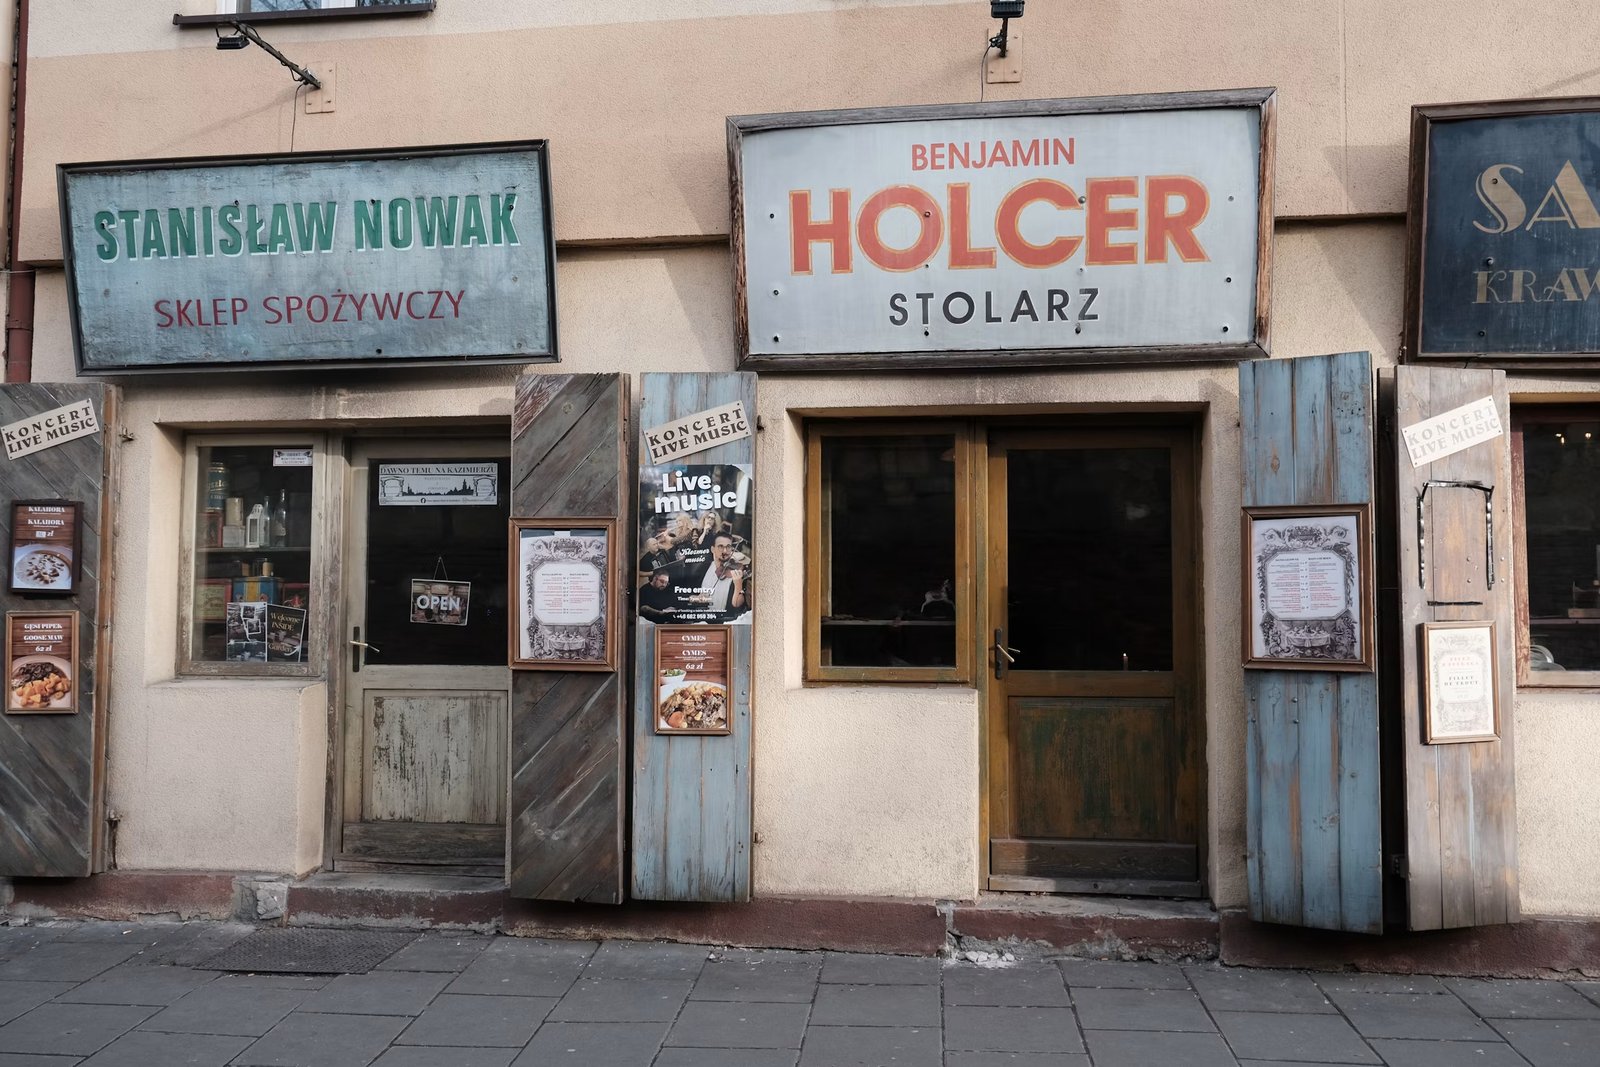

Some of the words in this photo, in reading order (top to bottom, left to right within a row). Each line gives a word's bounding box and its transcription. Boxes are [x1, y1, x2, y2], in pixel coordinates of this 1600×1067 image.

[911, 137, 1075, 171] BENJAMIN
[1472, 159, 1600, 234] SA
[94, 201, 338, 264] STANISŁAW
[354, 193, 521, 252] NOWAK
[789, 174, 1211, 276] HOLCER
[153, 297, 249, 329] SKLEP
[264, 288, 465, 325] SPOŻYWCZY
[889, 287, 1100, 326] STOLARZ
[5, 406, 91, 442] KONCERT
[8, 434, 42, 453] LIVE
[46, 418, 95, 441] MUSIC
[648, 408, 742, 447] KONCERT
[652, 438, 689, 459] LIVE
[693, 421, 747, 445] MUSIC
[1407, 405, 1494, 447] KONCERT
[1410, 438, 1447, 460] LIVE
[1452, 418, 1499, 445] MUSIC
[654, 485, 737, 513] music
[662, 470, 712, 493] Live
[416, 595, 460, 612] OPEN
[693, 586, 715, 594] entry
